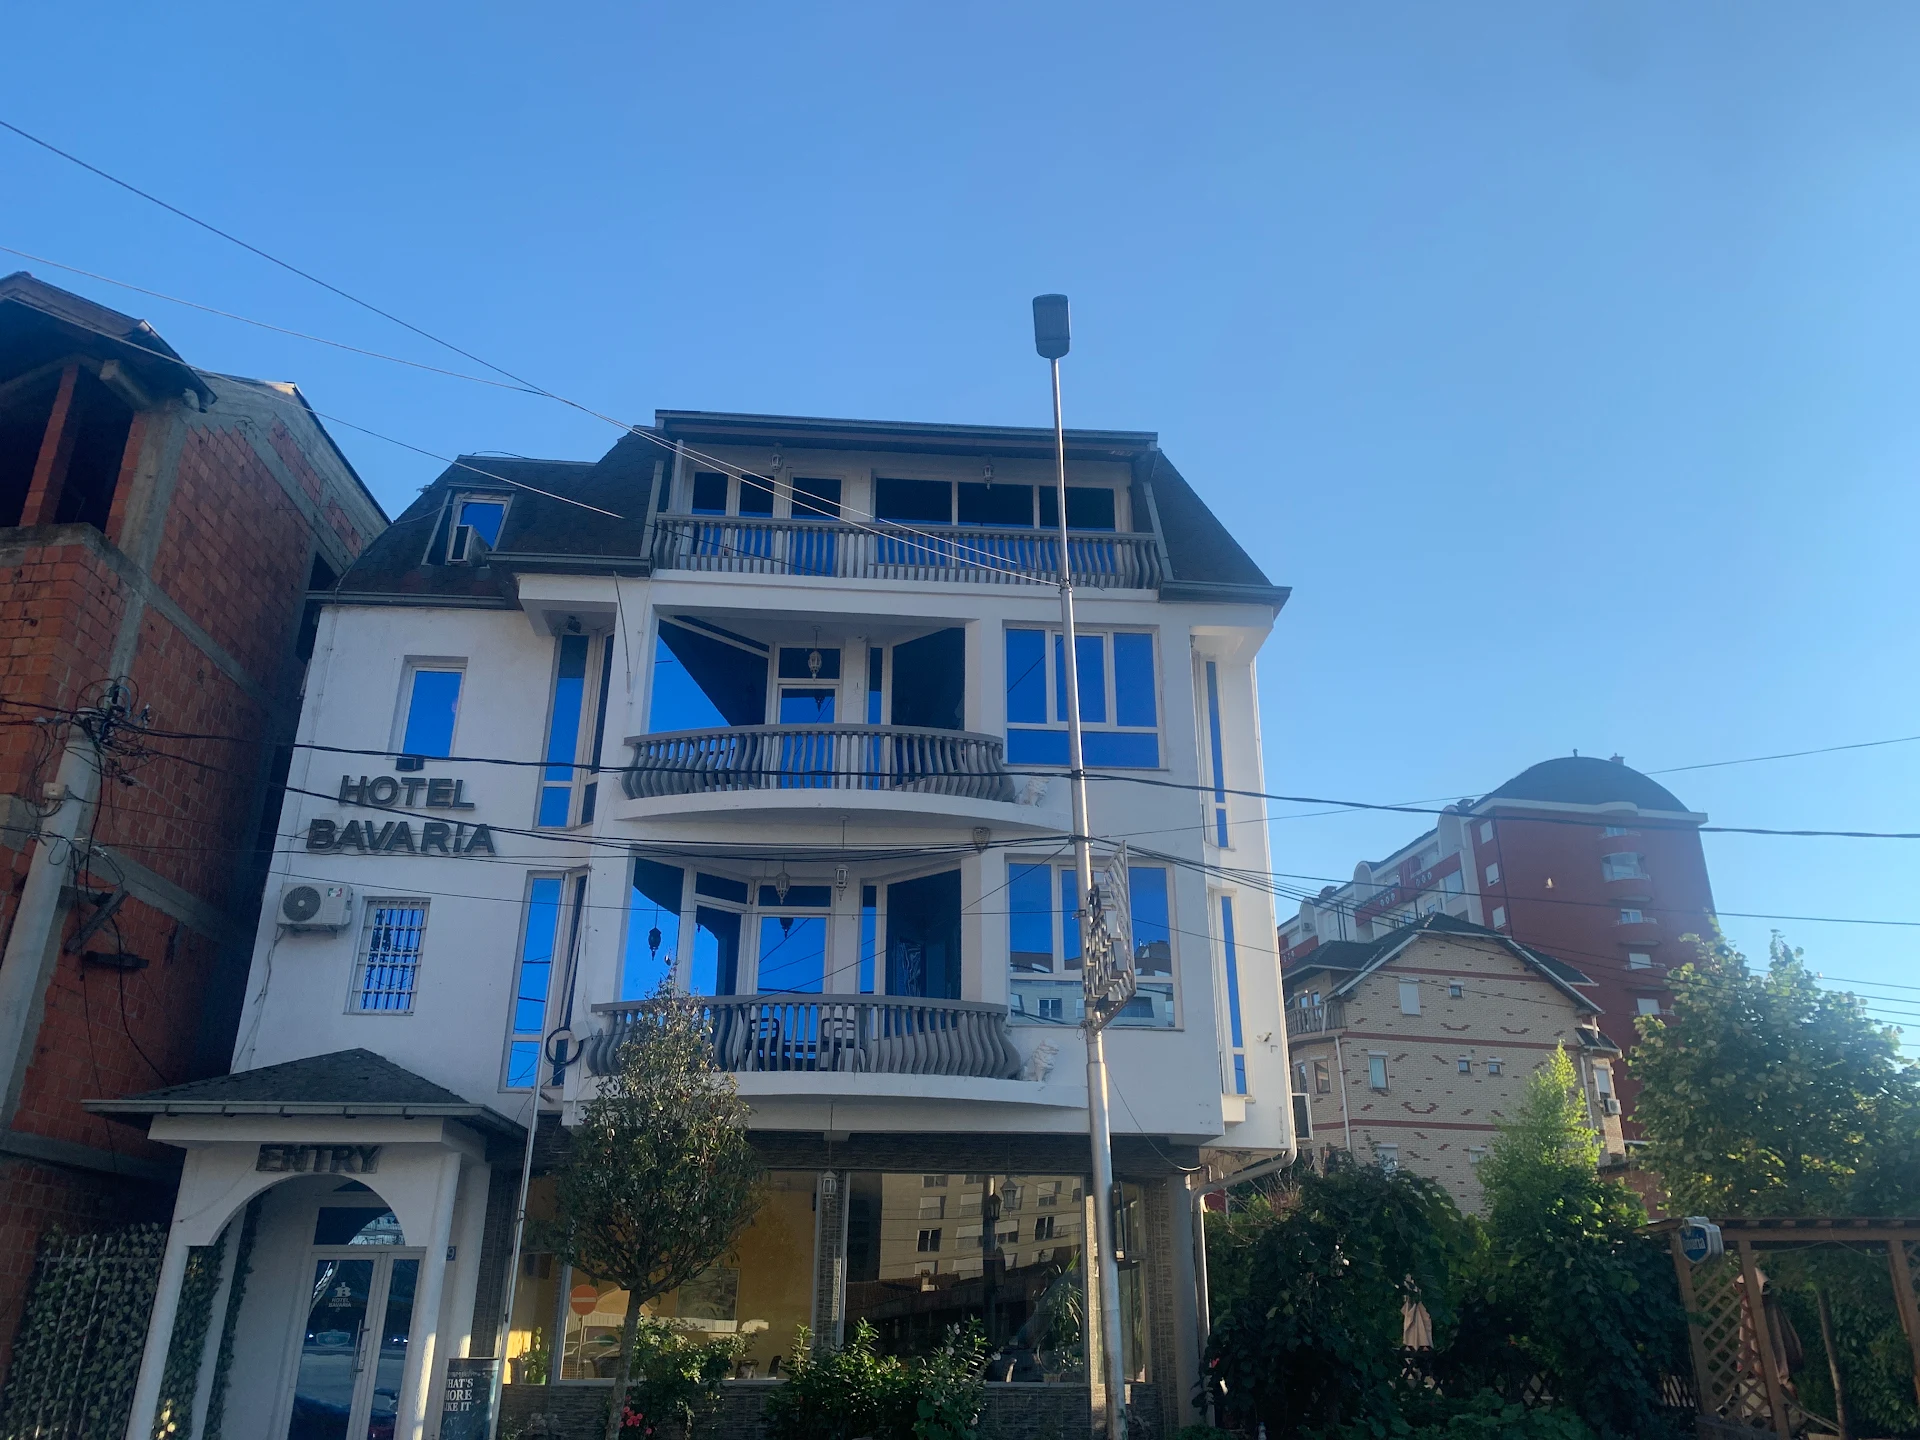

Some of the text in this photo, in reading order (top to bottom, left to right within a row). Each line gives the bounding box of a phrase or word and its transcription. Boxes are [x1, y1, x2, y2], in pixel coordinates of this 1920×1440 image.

[338, 775, 475, 810] HOTEL
[306, 818, 496, 855] BAVARIA
[256, 1144, 381, 1173] ENTRY
[447, 1378, 474, 1388] HAT'S
[460, 1402, 472, 1411] IT
